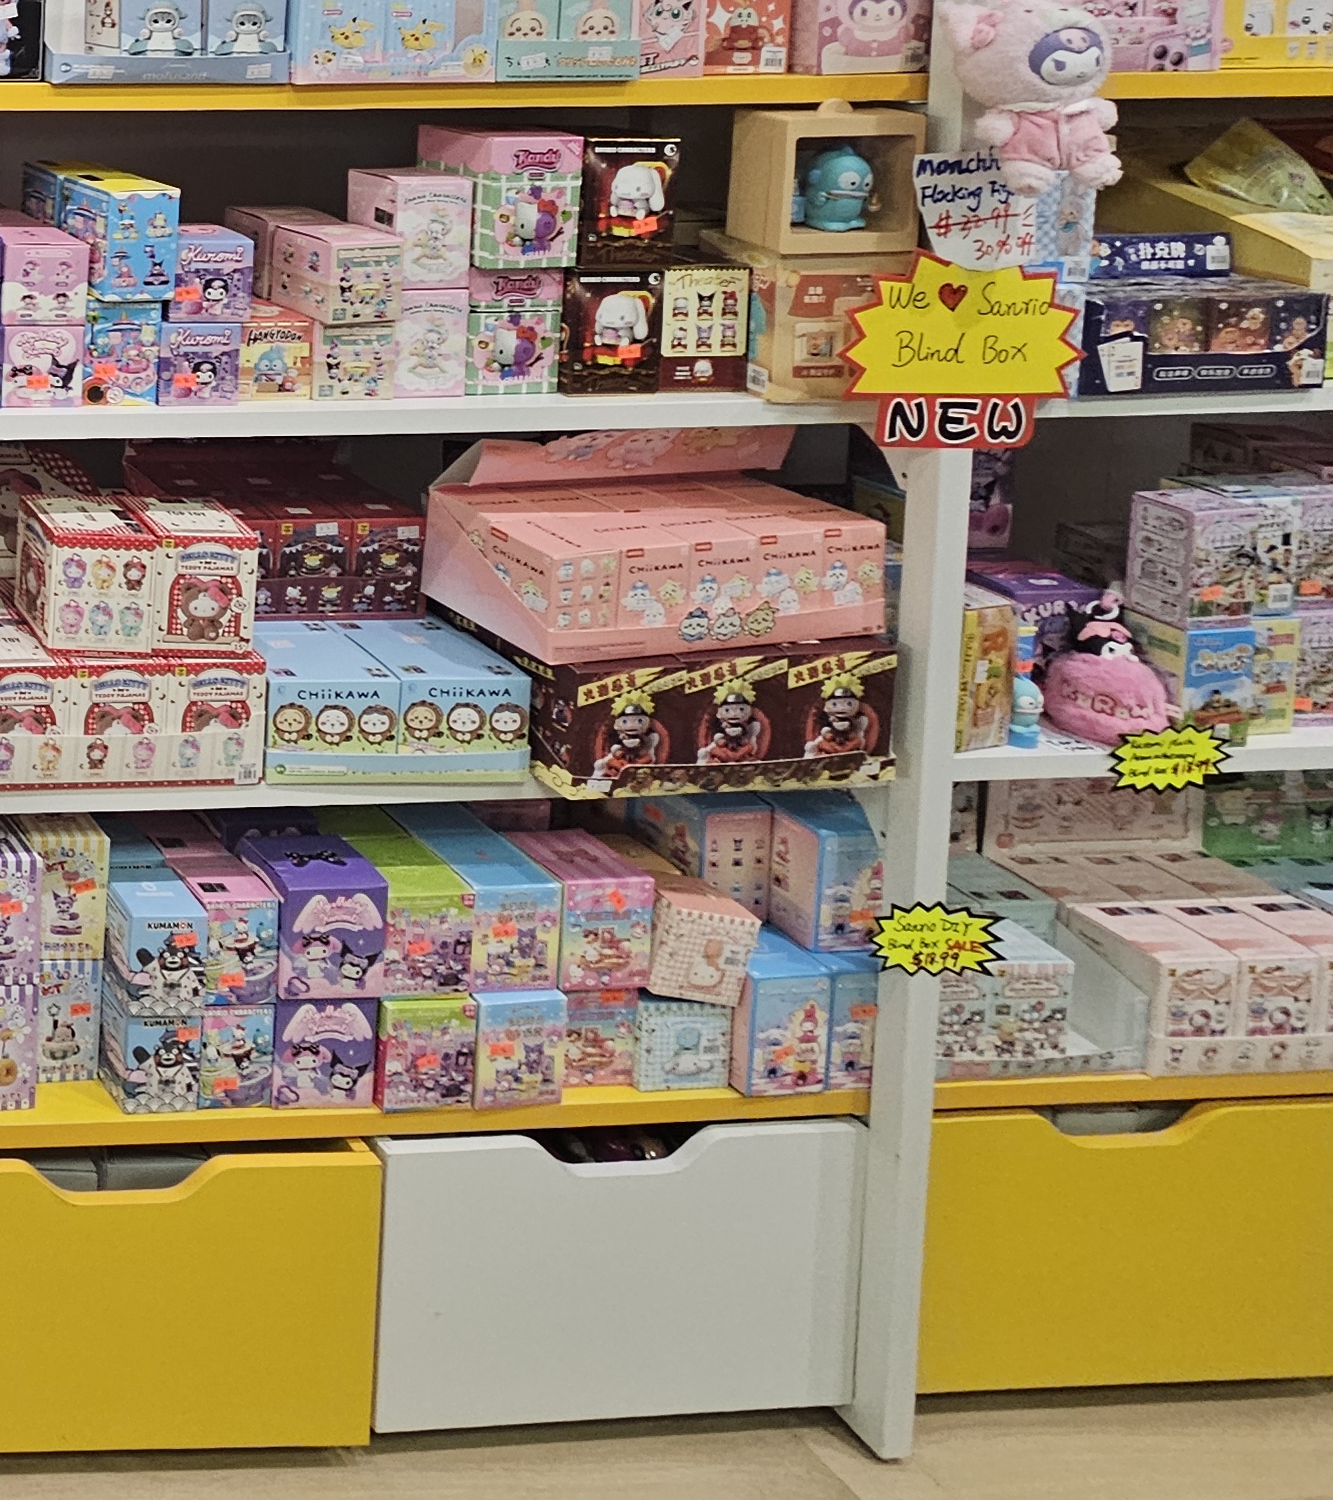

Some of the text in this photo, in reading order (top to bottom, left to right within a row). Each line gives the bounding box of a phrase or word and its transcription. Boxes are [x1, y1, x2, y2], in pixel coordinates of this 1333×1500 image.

[513, 146, 562, 173] Kandy
[920, 183, 983, 210] Flocking
[180, 245, 243, 267] Kuromi
[973, 239, 1011, 261] 30%
[493, 273, 544, 299] Kandy
[888, 281, 1051, 317] We Sanrio
[247, 328, 303, 347] HANGYODON
[895, 329, 1029, 369] Blind Box
[884, 396, 1025, 446] NEW
[180, 563, 234, 573] TEDDY PAJAMAS
[181, 551, 209, 563] HELLO
[146, 920, 194, 931] KUMAMON
[918, 938, 941, 951] Box
[944, 938, 983, 953] SALE
[908, 951, 961, 968] $18.99
[143, 1017, 189, 1028] KUMAMON
